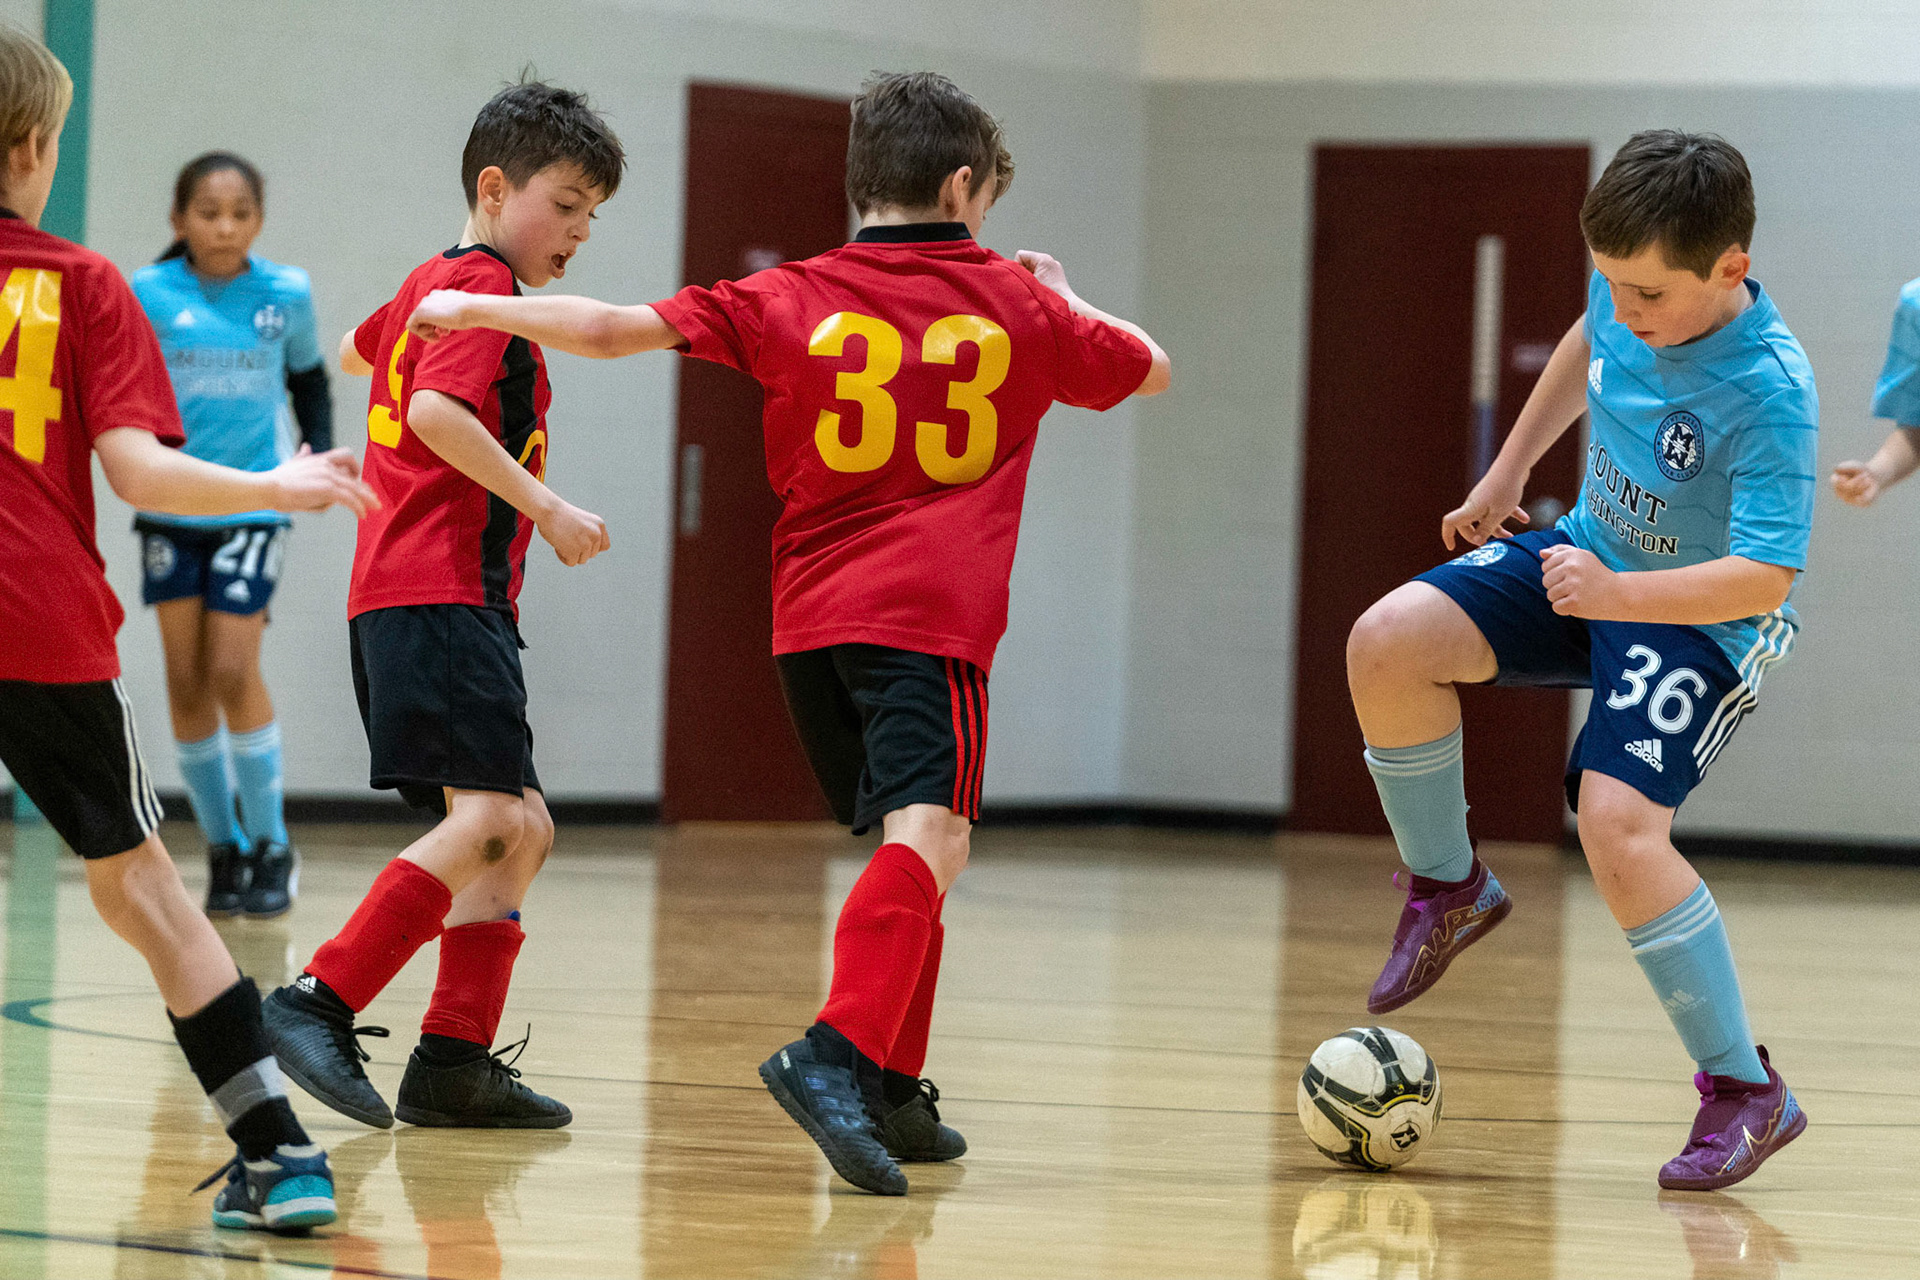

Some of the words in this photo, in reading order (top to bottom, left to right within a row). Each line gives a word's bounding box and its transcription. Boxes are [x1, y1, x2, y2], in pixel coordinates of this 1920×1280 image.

[0, 267, 62, 464] 4
[808, 311, 1011, 484] 33
[1606, 644, 1708, 734] 36
[1624, 742, 1664, 773] adidas
